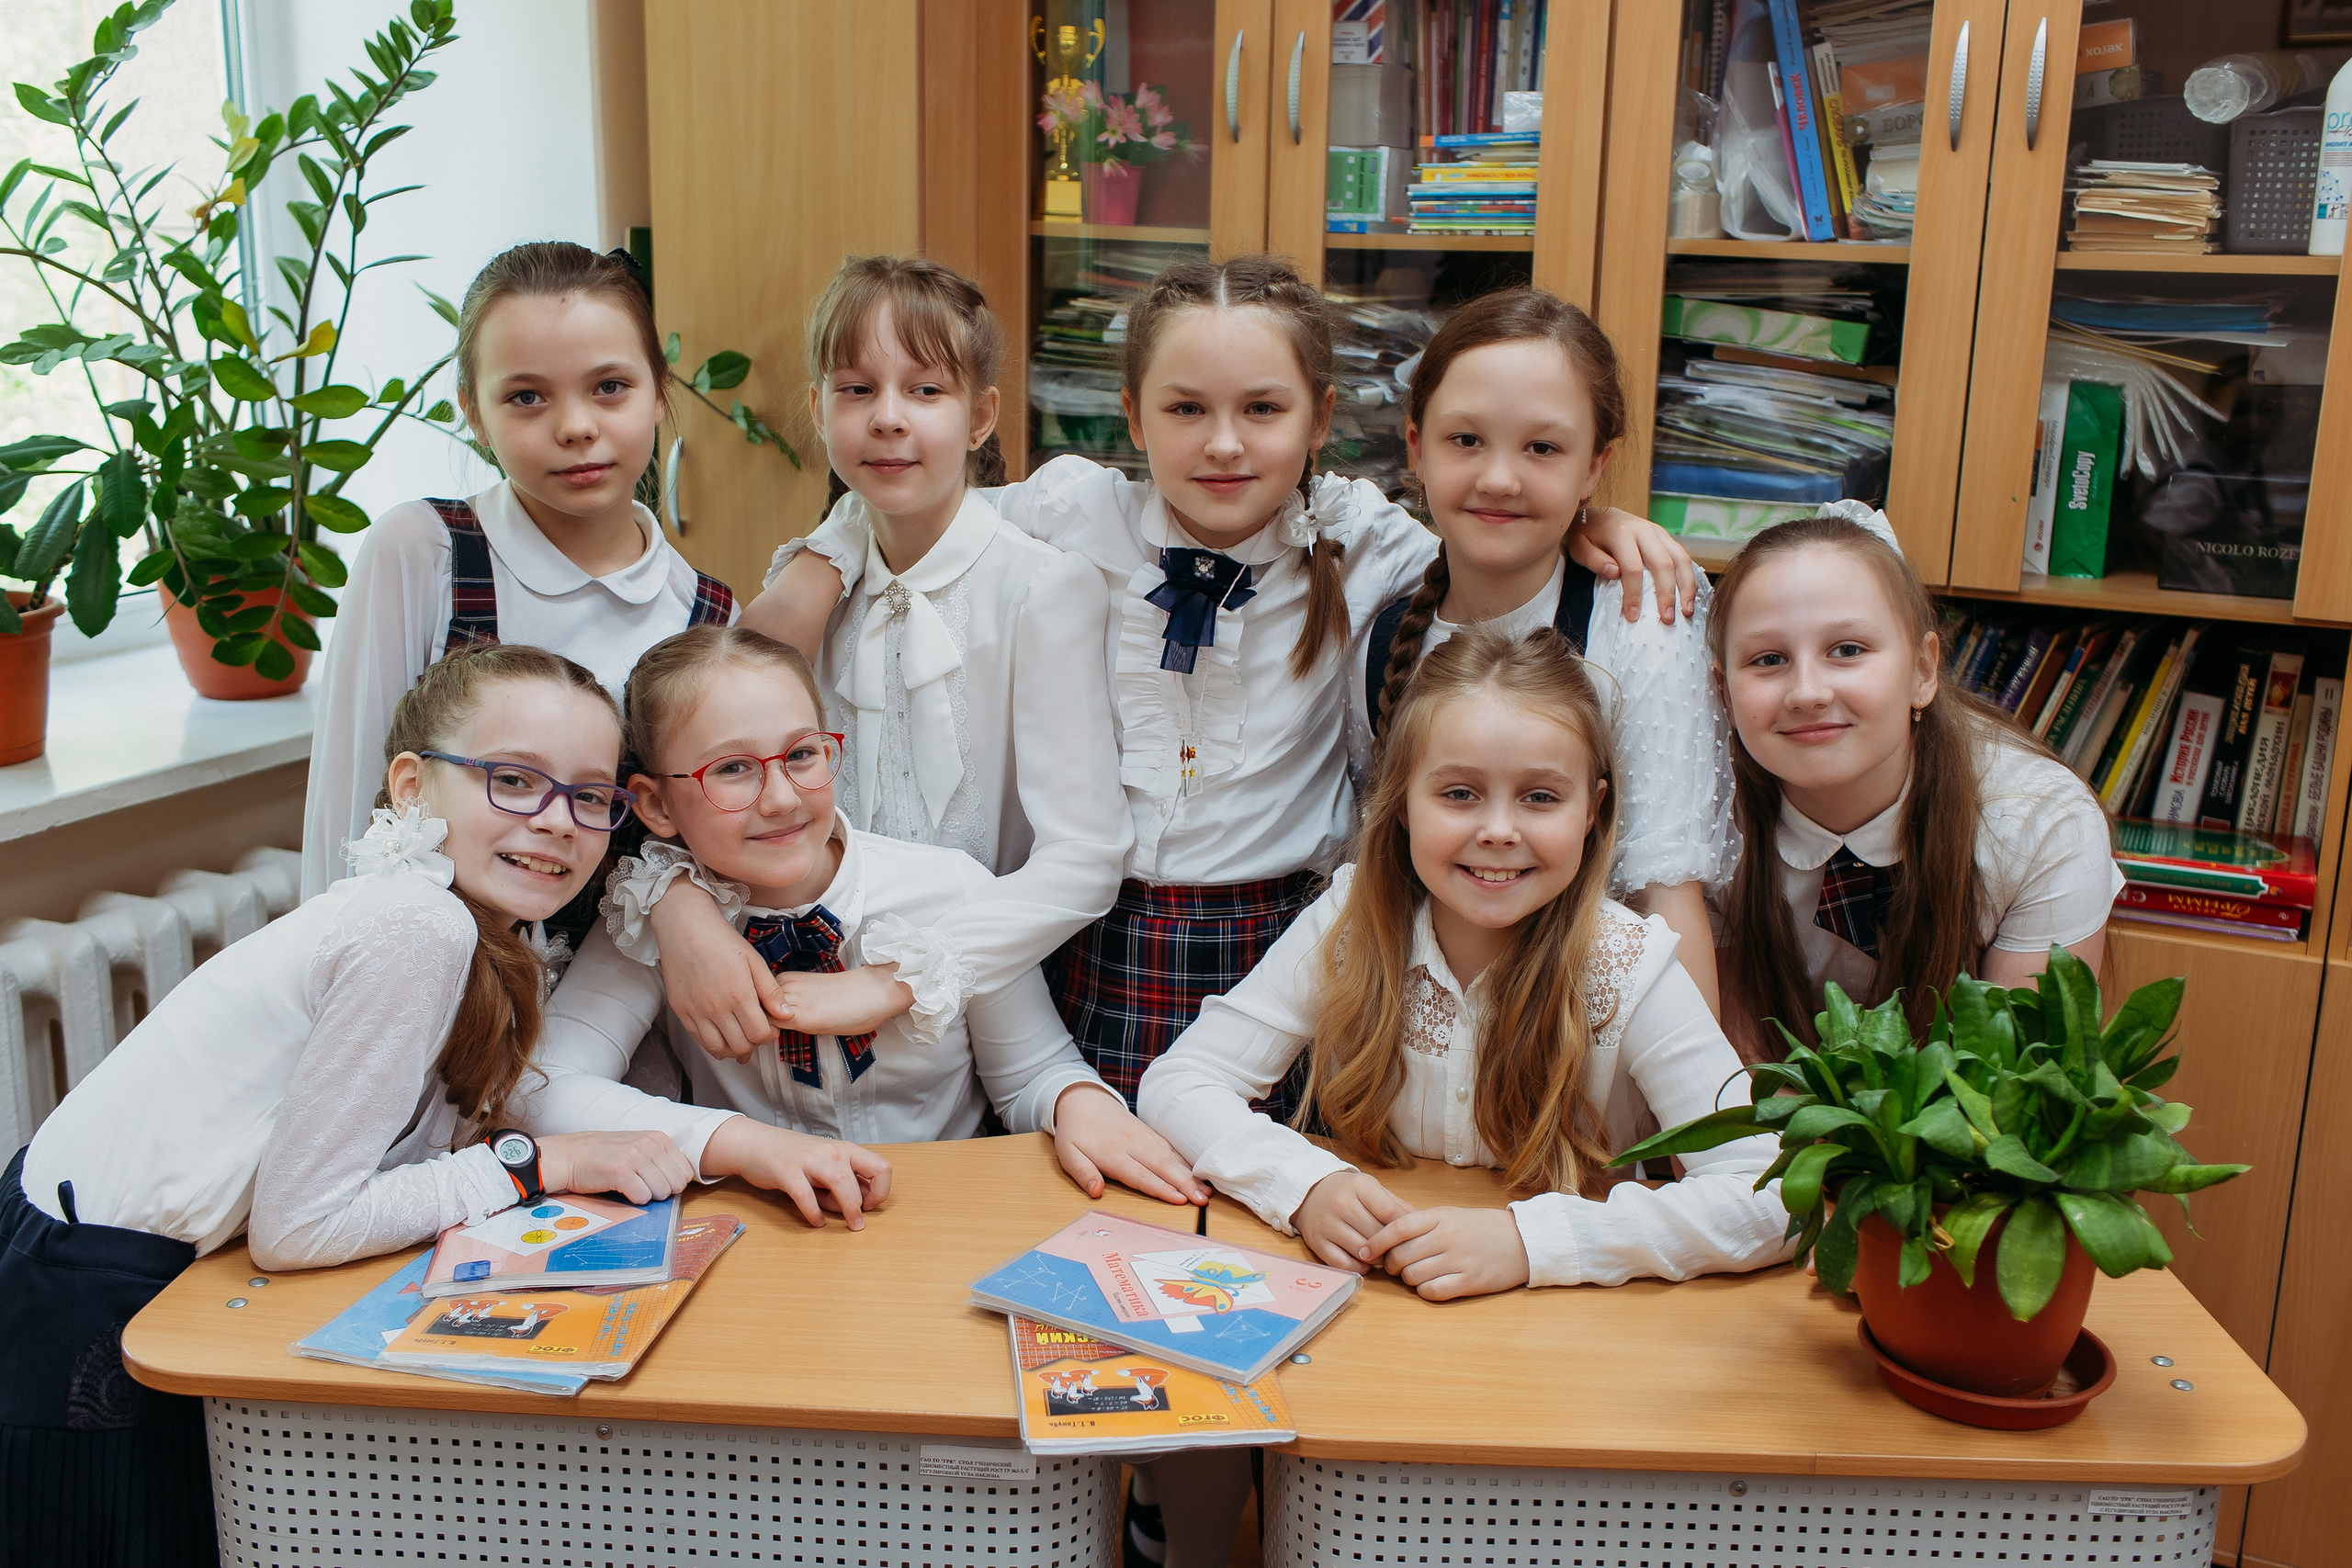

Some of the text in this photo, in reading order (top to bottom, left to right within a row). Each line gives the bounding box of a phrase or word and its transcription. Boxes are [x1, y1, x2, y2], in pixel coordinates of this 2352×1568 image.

[2326, 112, 2352, 135] pr
[2068, 450, 2096, 510] SvetoCopy
[2196, 541, 2254, 557] NICOLO
[2316, 706, 2333, 741] РОДИНЫ
[2169, 743, 2191, 784] История
[2180, 708, 2199, 743] России
[2312, 741, 2327, 772] БАШНИ
[2308, 772, 2324, 800] БЕЛЫЕ
[1102, 1252, 1148, 1317] Математика
[1295, 1278, 1322, 1289] 3
[531, 1345, 575, 1353] ФГОС
[1035, 1332, 1098, 1345] СКИЙ
[1181, 1414, 1226, 1422] ФГОС
